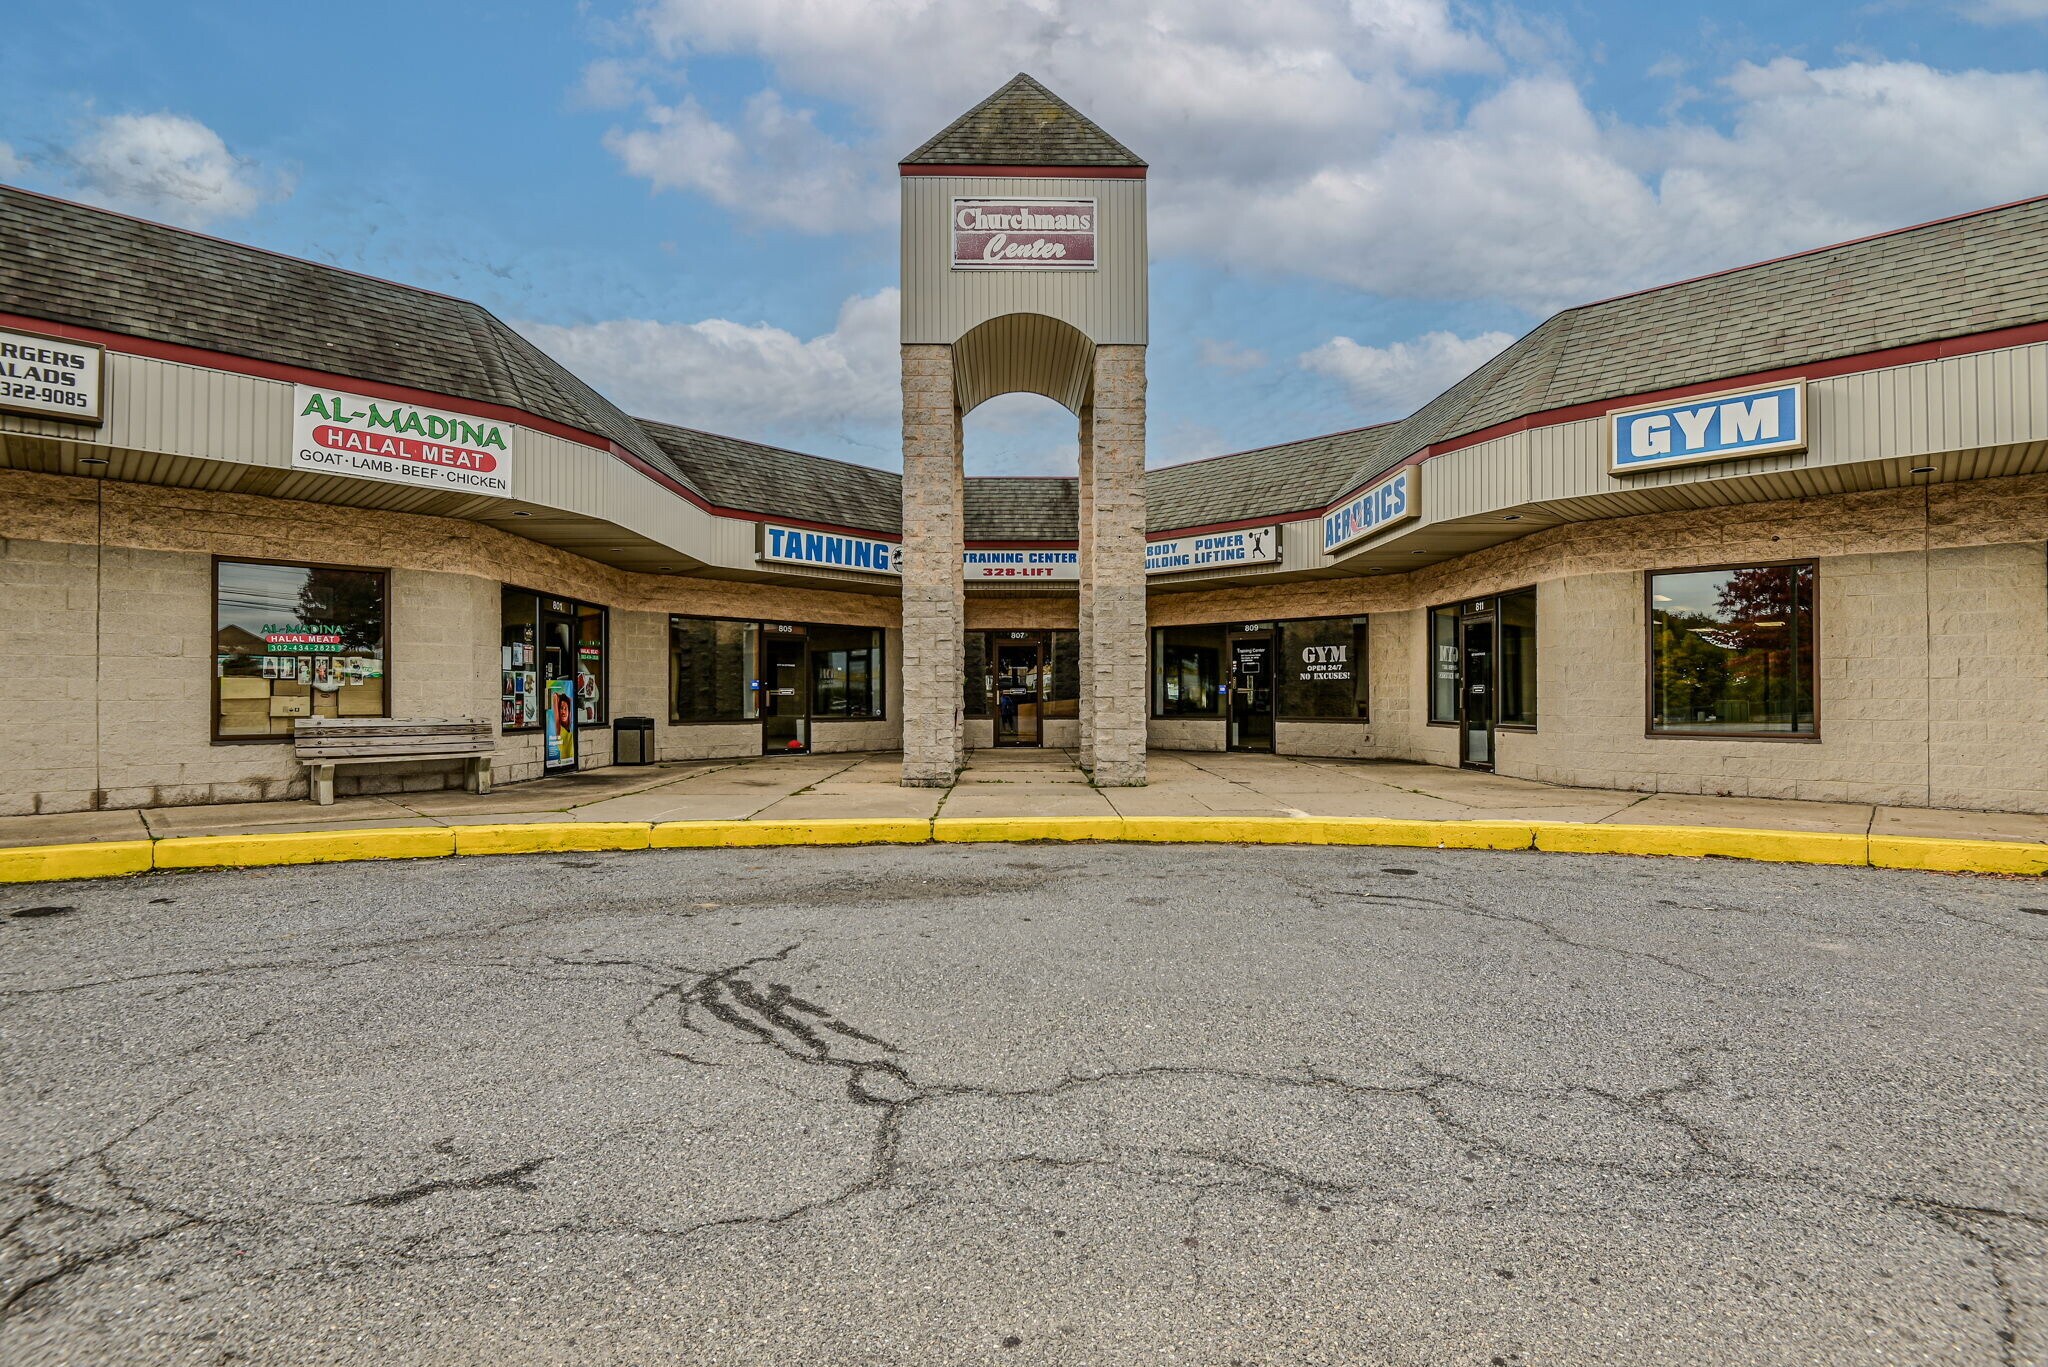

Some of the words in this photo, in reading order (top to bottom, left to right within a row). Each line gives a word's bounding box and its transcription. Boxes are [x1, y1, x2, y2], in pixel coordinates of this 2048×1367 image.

[957, 207, 1091, 230] Churchmans
[983, 233, 1067, 263] Center
[300, 393, 507, 450] AL-MADINA
[1630, 395, 1779, 457] GYM
[327, 429, 411, 457] HALAL
[422, 444, 484, 469] MEAT
[299, 449, 343, 465] GOAT
[352, 456, 393, 473] LAMB
[401, 464, 439, 479] BEEF
[446, 471, 506, 490] CHICKEN
[1325, 476, 1406, 548] AEROBICS
[768, 528, 889, 570] TANNING
[1146, 543, 1178, 556] BODY
[1195, 534, 1244, 550] POWER
[963, 552, 1024, 563] TRAINING
[1028, 552, 1077, 563] CENTER
[1195, 547, 1245, 564] LIFTING
[982, 567, 1054, 577] 328-LIFT
[552, 600, 563, 611] 801
[260, 623, 346, 635] AL-MADINA
[778, 625, 793, 633] 805
[1244, 624, 1259, 632] 809
[271, 635, 305, 643] HALAL
[308, 635, 335, 643] MEAT
[271, 644, 336, 652] 302-434-2825
[1302, 645, 1347, 663] GYM
[1300, 672, 1311, 680] NO
[1313, 671, 1350, 680] EXCUSES!
